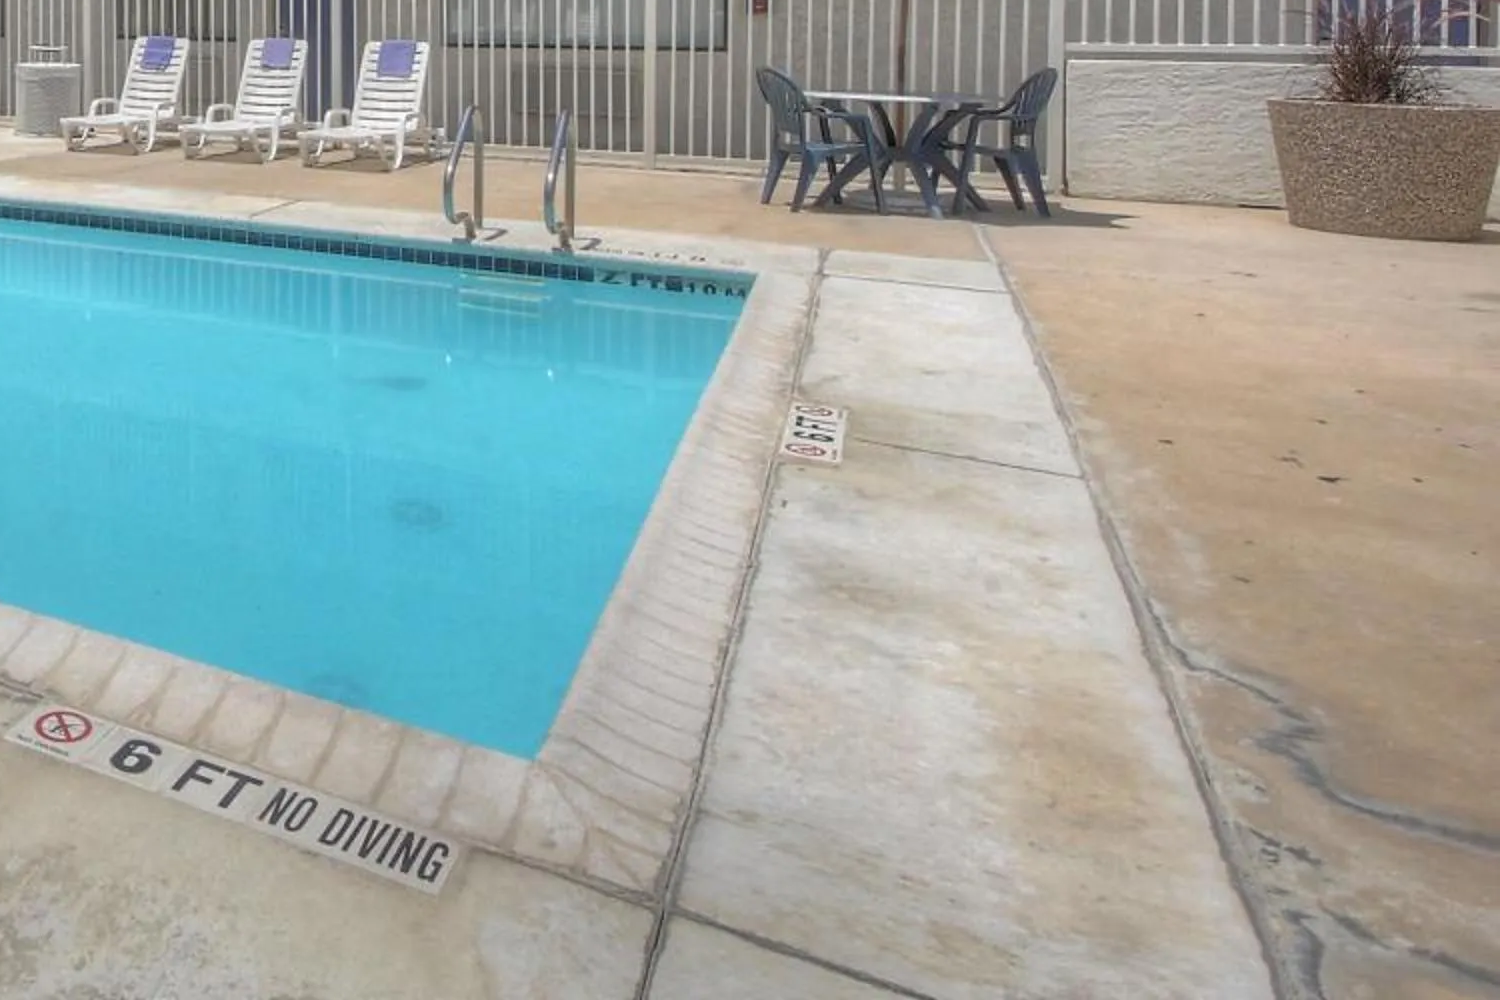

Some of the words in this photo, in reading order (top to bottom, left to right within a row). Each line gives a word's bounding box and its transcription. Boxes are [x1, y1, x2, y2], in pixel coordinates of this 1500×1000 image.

[109, 739, 162, 774] 6
[171, 759, 264, 809] FT
[259, 787, 318, 832] NO
[318, 808, 449, 884] DIVING
